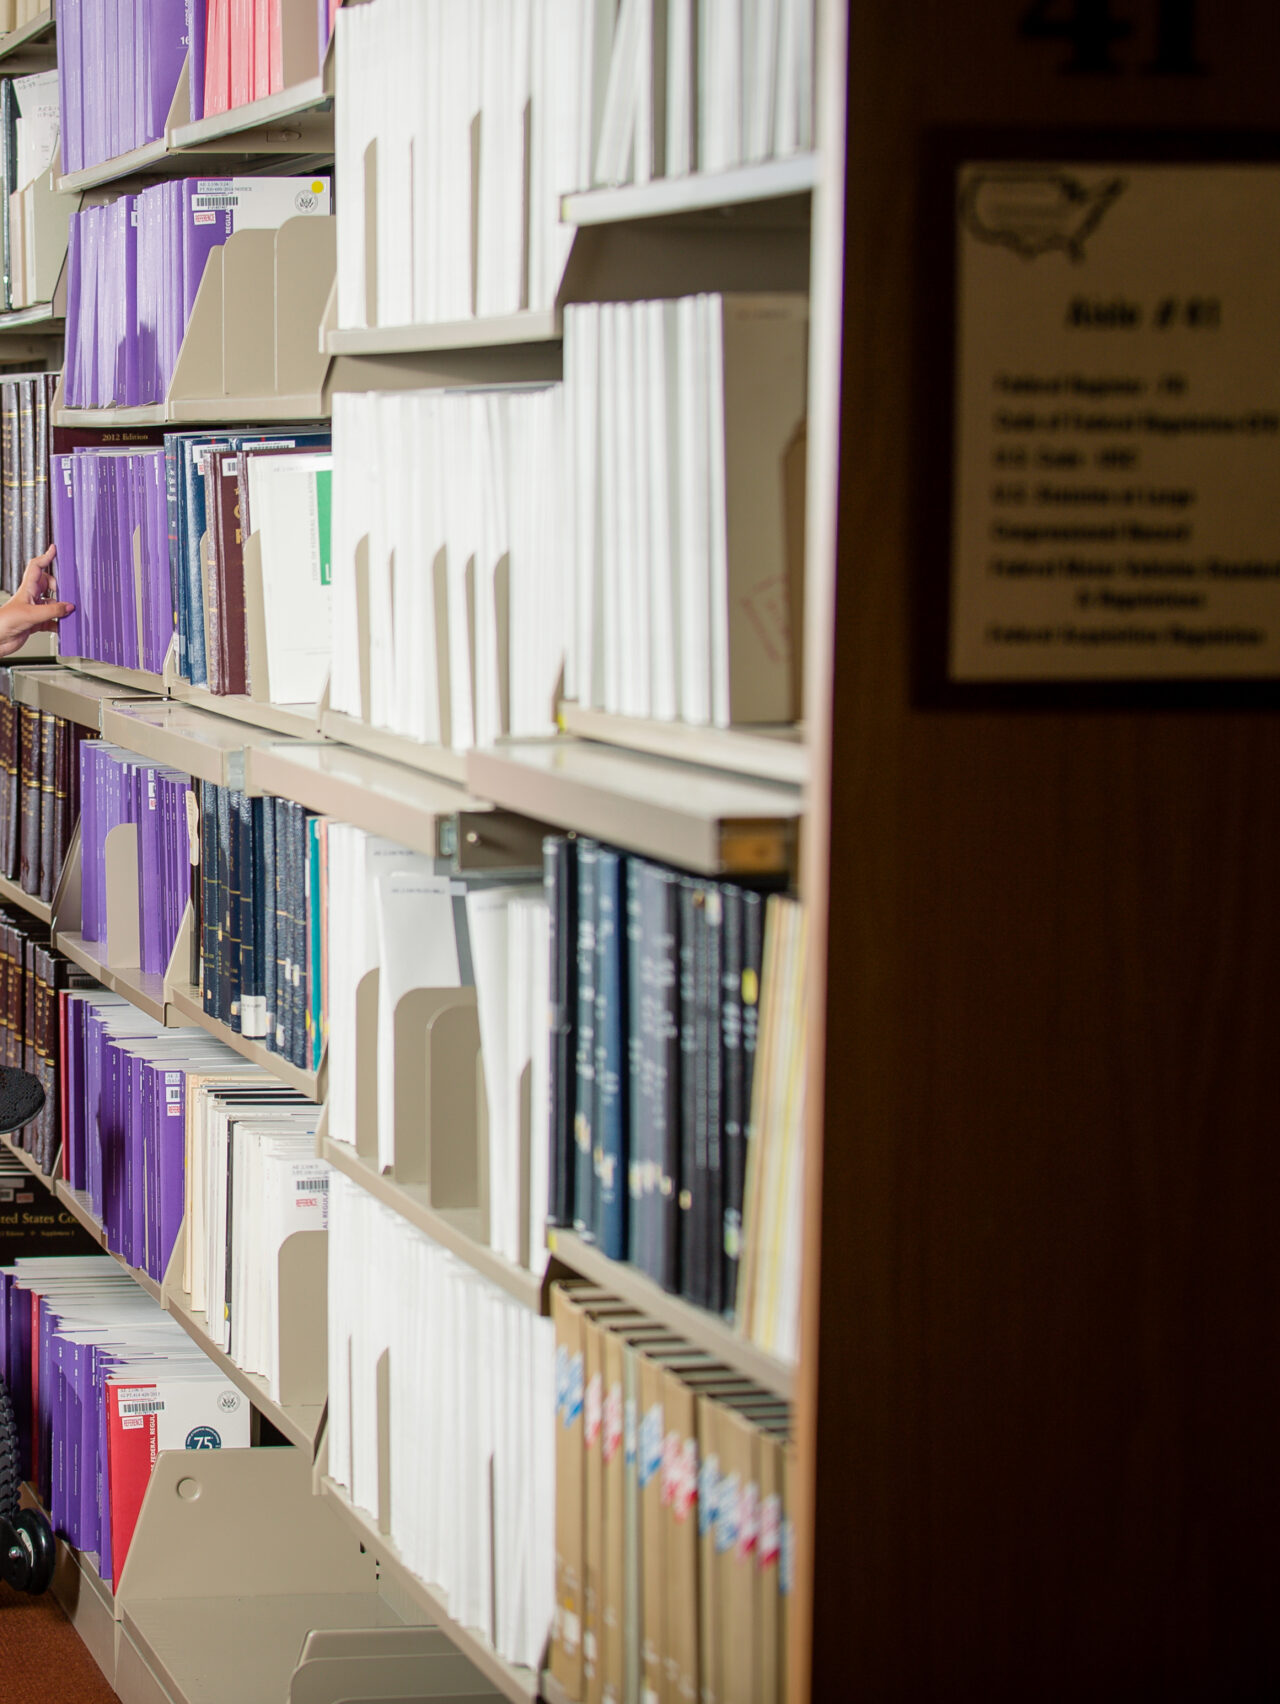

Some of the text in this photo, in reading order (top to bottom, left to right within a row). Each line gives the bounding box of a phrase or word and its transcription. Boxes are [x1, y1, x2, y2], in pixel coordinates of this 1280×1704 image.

[1068, 296, 1139, 328] Aisle
[102, 432, 149, 441] 2012 Edition
[22, 1213, 54, 1224] States
